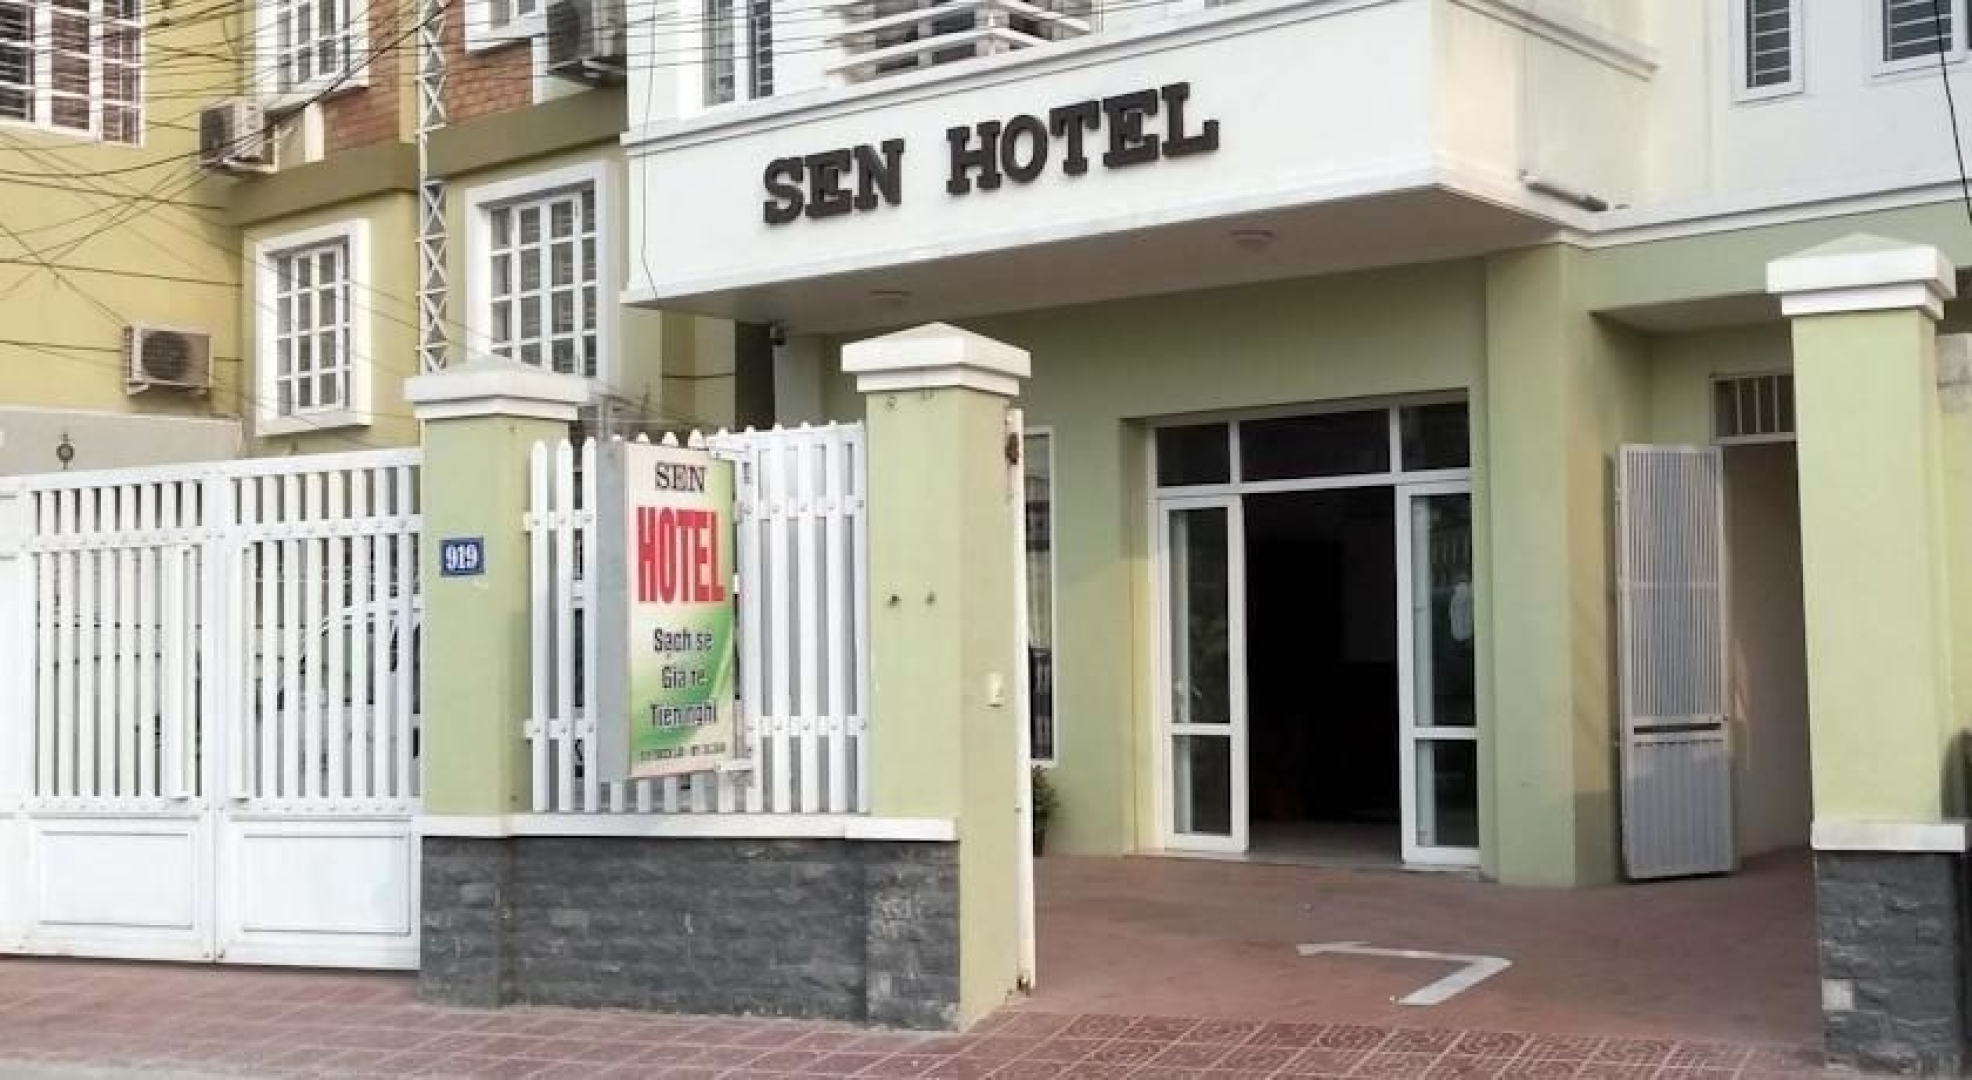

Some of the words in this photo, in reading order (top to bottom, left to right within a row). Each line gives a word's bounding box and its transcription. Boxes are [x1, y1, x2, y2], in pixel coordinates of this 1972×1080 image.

[763, 138, 904, 224] SEN
[945, 81, 1220, 196] HOTEL
[655, 462, 706, 492] SEN
[445, 544, 478, 570] 919
[638, 506, 726, 602] HOTEL
